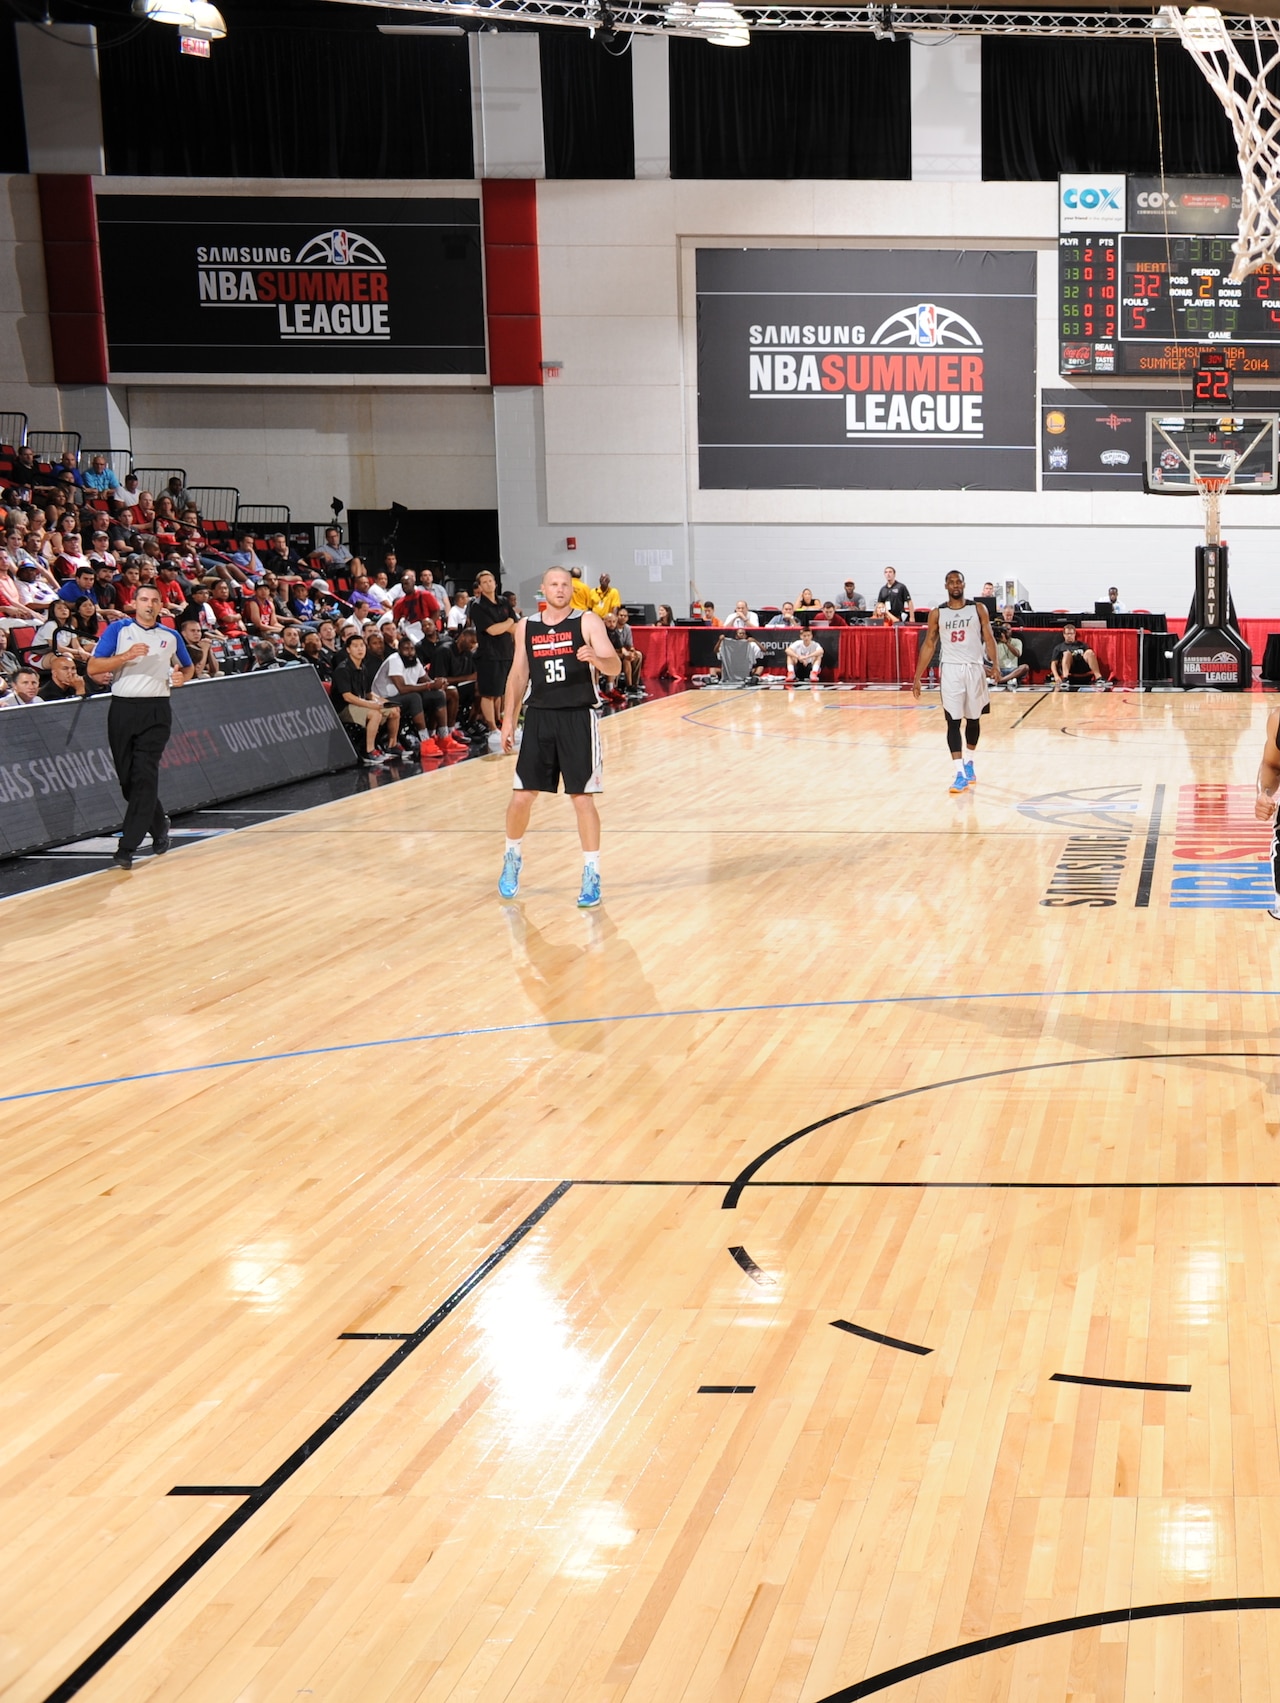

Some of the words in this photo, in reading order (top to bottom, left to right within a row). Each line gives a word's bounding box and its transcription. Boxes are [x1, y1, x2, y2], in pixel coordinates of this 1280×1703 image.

[1063, 187, 1122, 210] COX
[1136, 192, 1178, 208] COX
[1060, 238, 1078, 246] PLYR
[1086, 238, 1092, 246] F
[1098, 238, 1114, 246] PTS
[197, 246, 291, 263] SAMSUNG
[1084, 249, 1093, 262] 2
[1106, 249, 1114, 262] 6
[1084, 267, 1093, 280] 0
[1106, 268, 1114, 280] 3
[1136, 263, 1167, 273] HEAT
[198, 271, 258, 300] NBA
[258, 271, 388, 301] SUMMER
[1063, 286, 1080, 298] 32
[1101, 286, 1114, 298] 10
[1133, 274, 1160, 297] 32
[1199, 276, 1212, 298] 2
[1123, 298, 1148, 306] FOULS
[1184, 299, 1215, 307] PLAYER
[1219, 299, 1240, 307] FOUL
[1063, 304, 1080, 316] 56
[1084, 304, 1093, 317] 0
[1106, 304, 1114, 317] 0
[278, 304, 390, 334] LEAGUE
[1132, 307, 1146, 329] 5
[1186, 309, 1212, 330] 63
[1225, 309, 1236, 330] 3
[749, 325, 866, 344] SAMSUNG
[1063, 323, 1080, 335] 63
[1084, 322, 1093, 335] 3
[1106, 322, 1114, 335] 2
[1140, 358, 1186, 369] SUMMER
[1243, 359, 1270, 371] 2014
[750, 355, 821, 391] NBA
[821, 355, 984, 392] SUMMER
[1196, 372, 1229, 398] 22
[846, 394, 984, 431] LEAGUE
[946, 616, 973, 629] HEAT
[531, 632, 572, 644] HOUSTON
[951, 630, 965, 642] 63
[533, 647, 573, 658] BASKETBALL
[544, 658, 566, 683] 35
[1184, 663, 1201, 672] NBA
[1201, 663, 1238, 672] SUMMER
[1206, 672, 1238, 681] LEAGUE
[220, 705, 339, 753] UNLVTICKETS.COM
[0, 763, 34, 802] AS
[29, 747, 119, 794] SHOWCA
[1039, 835, 1130, 907] SAMSUNG
